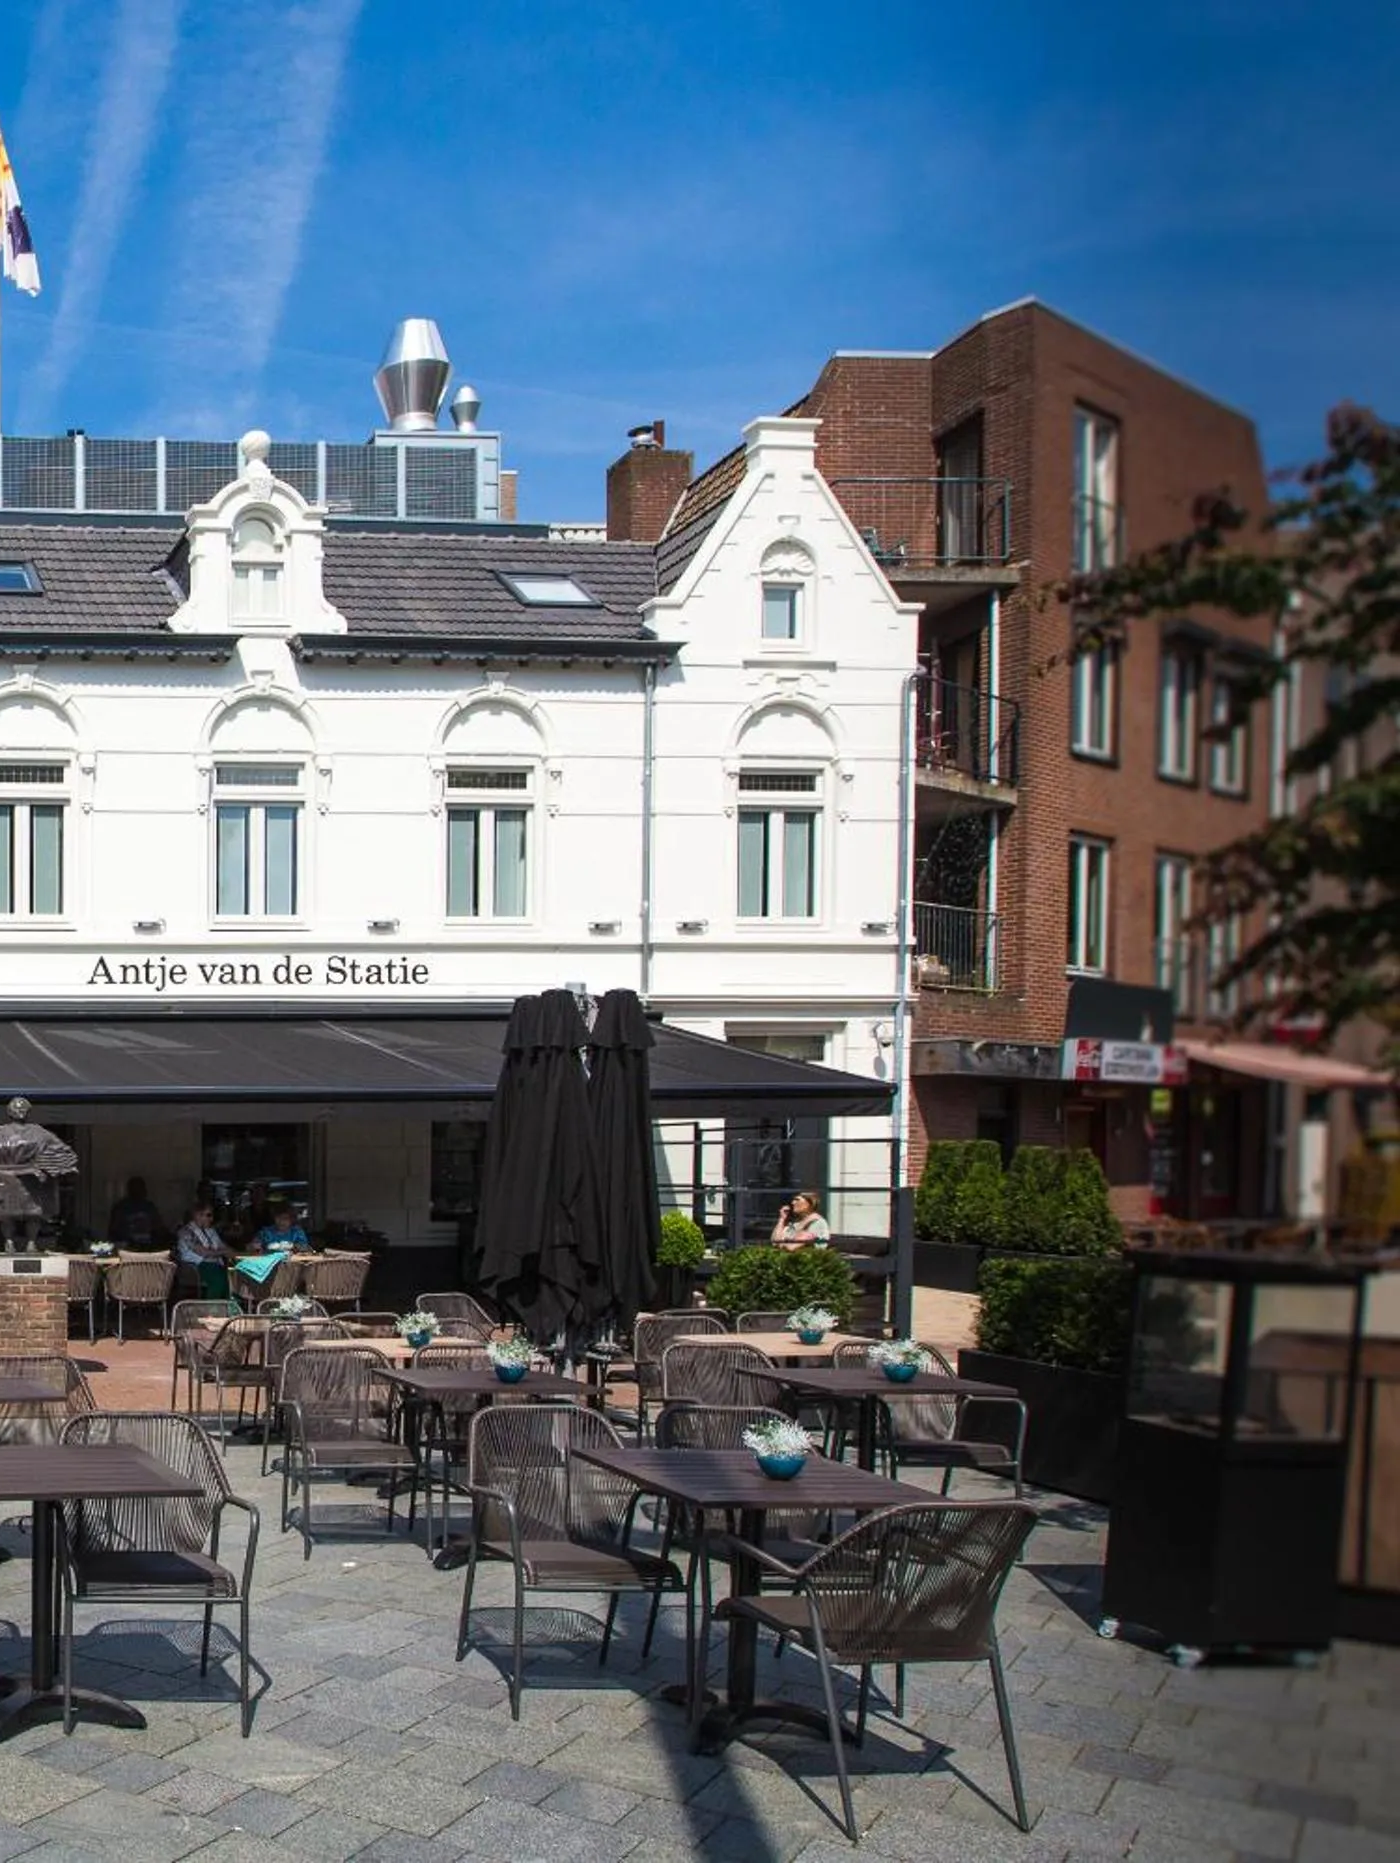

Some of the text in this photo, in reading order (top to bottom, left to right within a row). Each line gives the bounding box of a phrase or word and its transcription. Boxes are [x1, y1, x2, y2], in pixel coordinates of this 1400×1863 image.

[86, 955, 430, 992] Antje van de Statie
